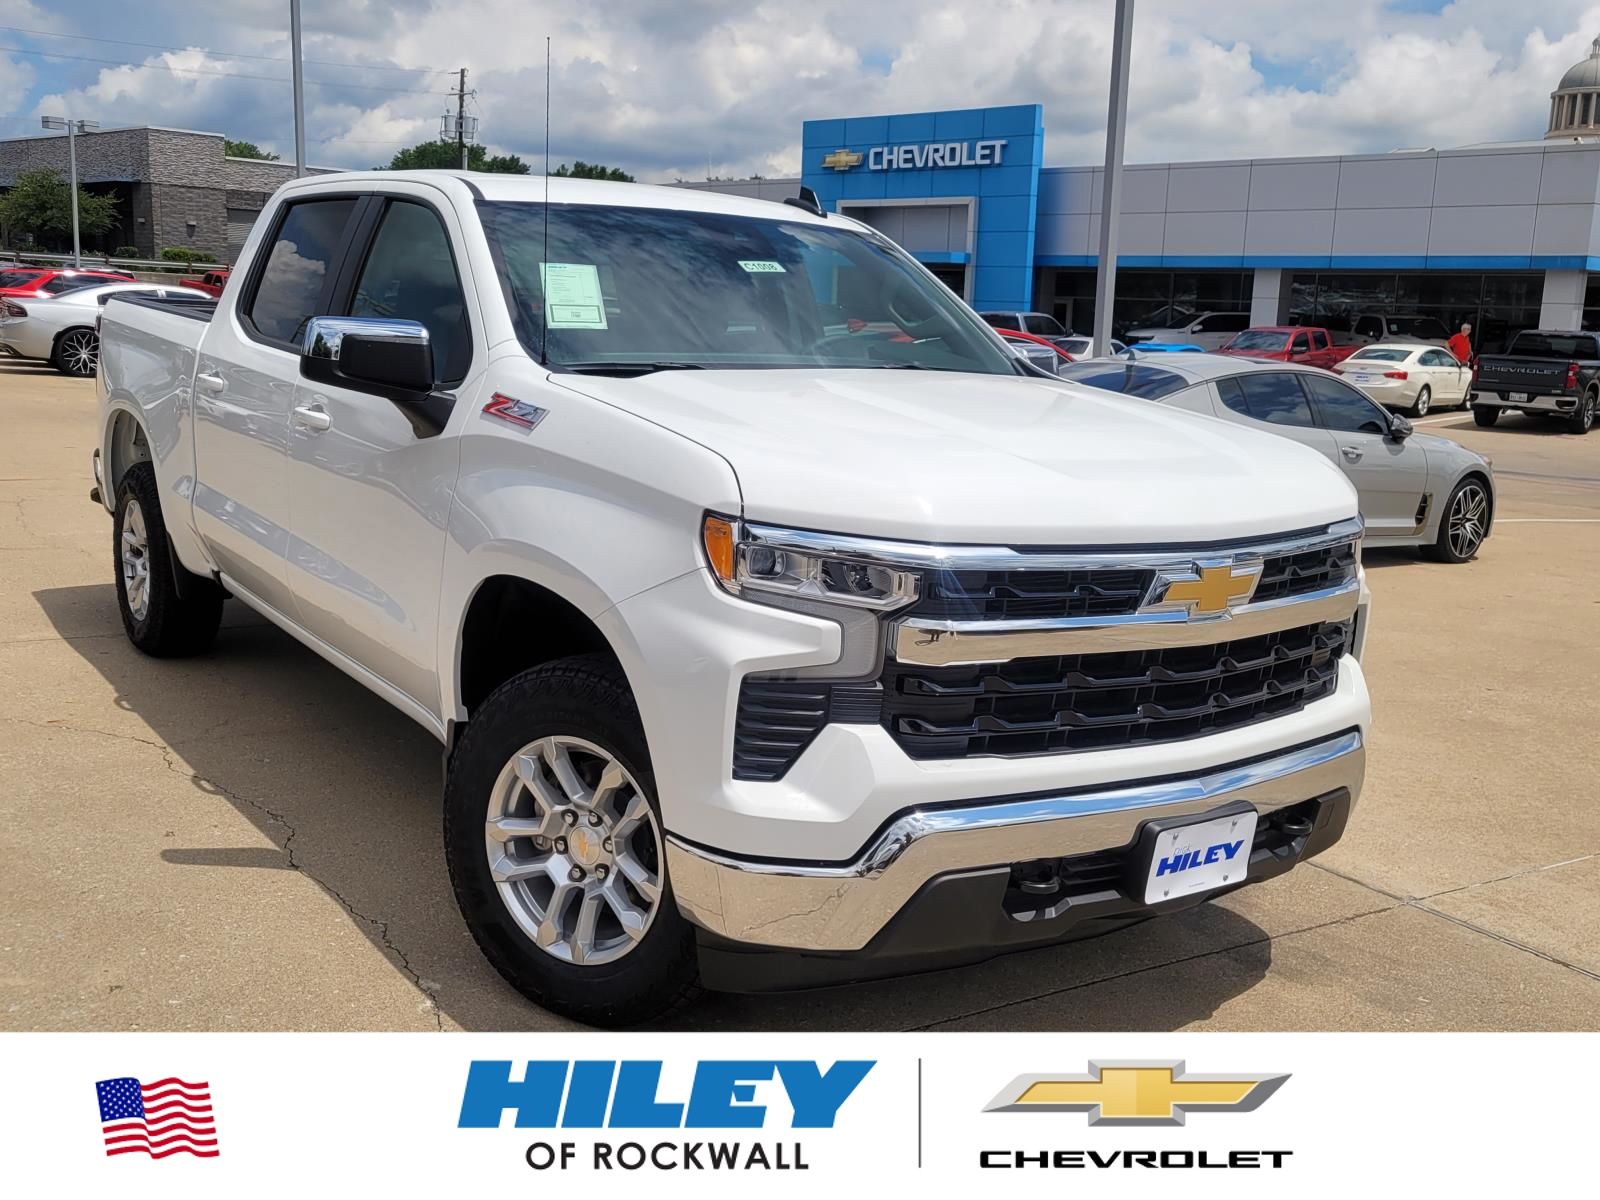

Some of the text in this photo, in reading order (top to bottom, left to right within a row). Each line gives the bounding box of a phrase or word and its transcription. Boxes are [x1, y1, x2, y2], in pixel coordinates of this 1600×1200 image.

[869, 140, 1008, 170] CHEVROLET
[1483, 364, 1561, 375] CHEVROLET
[482, 392, 549, 430] Z71
[1156, 840, 1245, 877] HILEY
